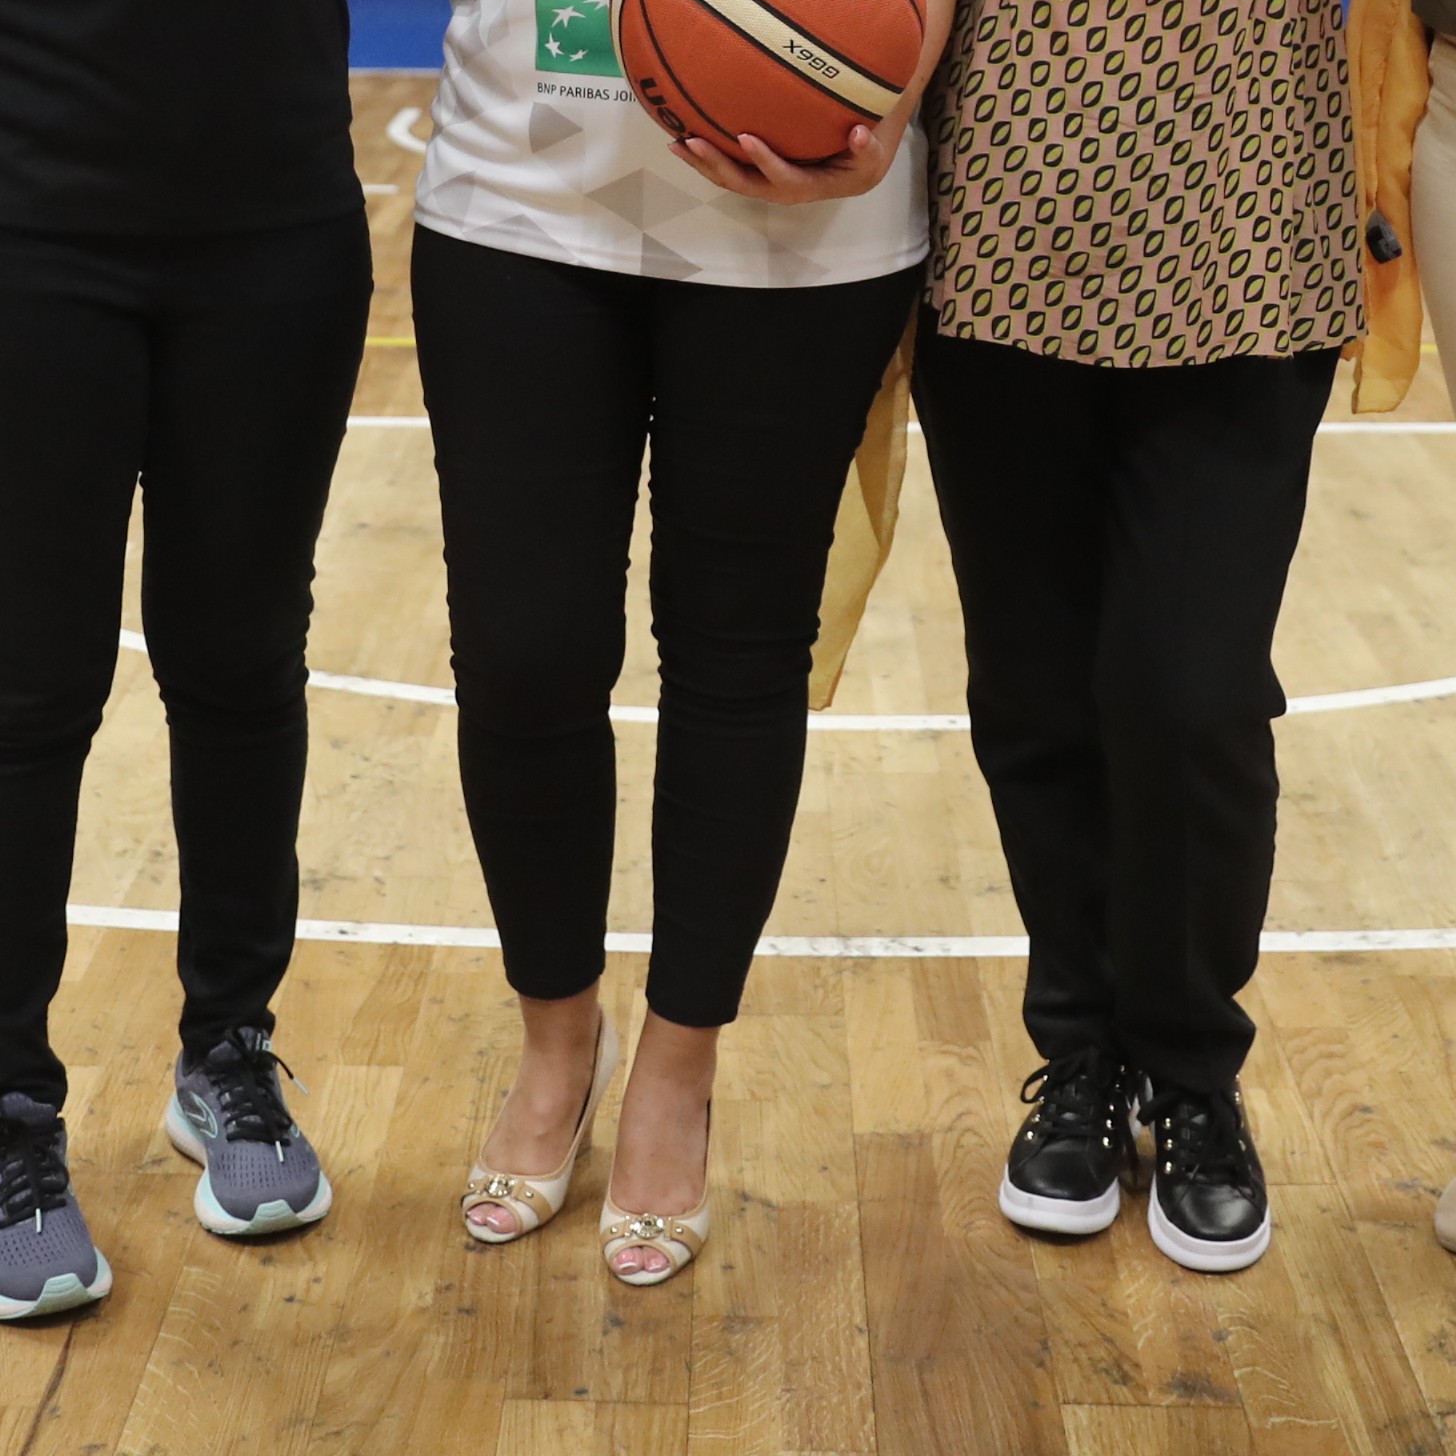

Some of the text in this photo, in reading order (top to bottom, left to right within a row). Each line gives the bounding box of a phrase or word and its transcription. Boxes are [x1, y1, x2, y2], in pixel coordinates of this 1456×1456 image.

[783, 39, 840, 78] GG6X
[537, 82, 637, 103] BNP PARIBAS JOI
